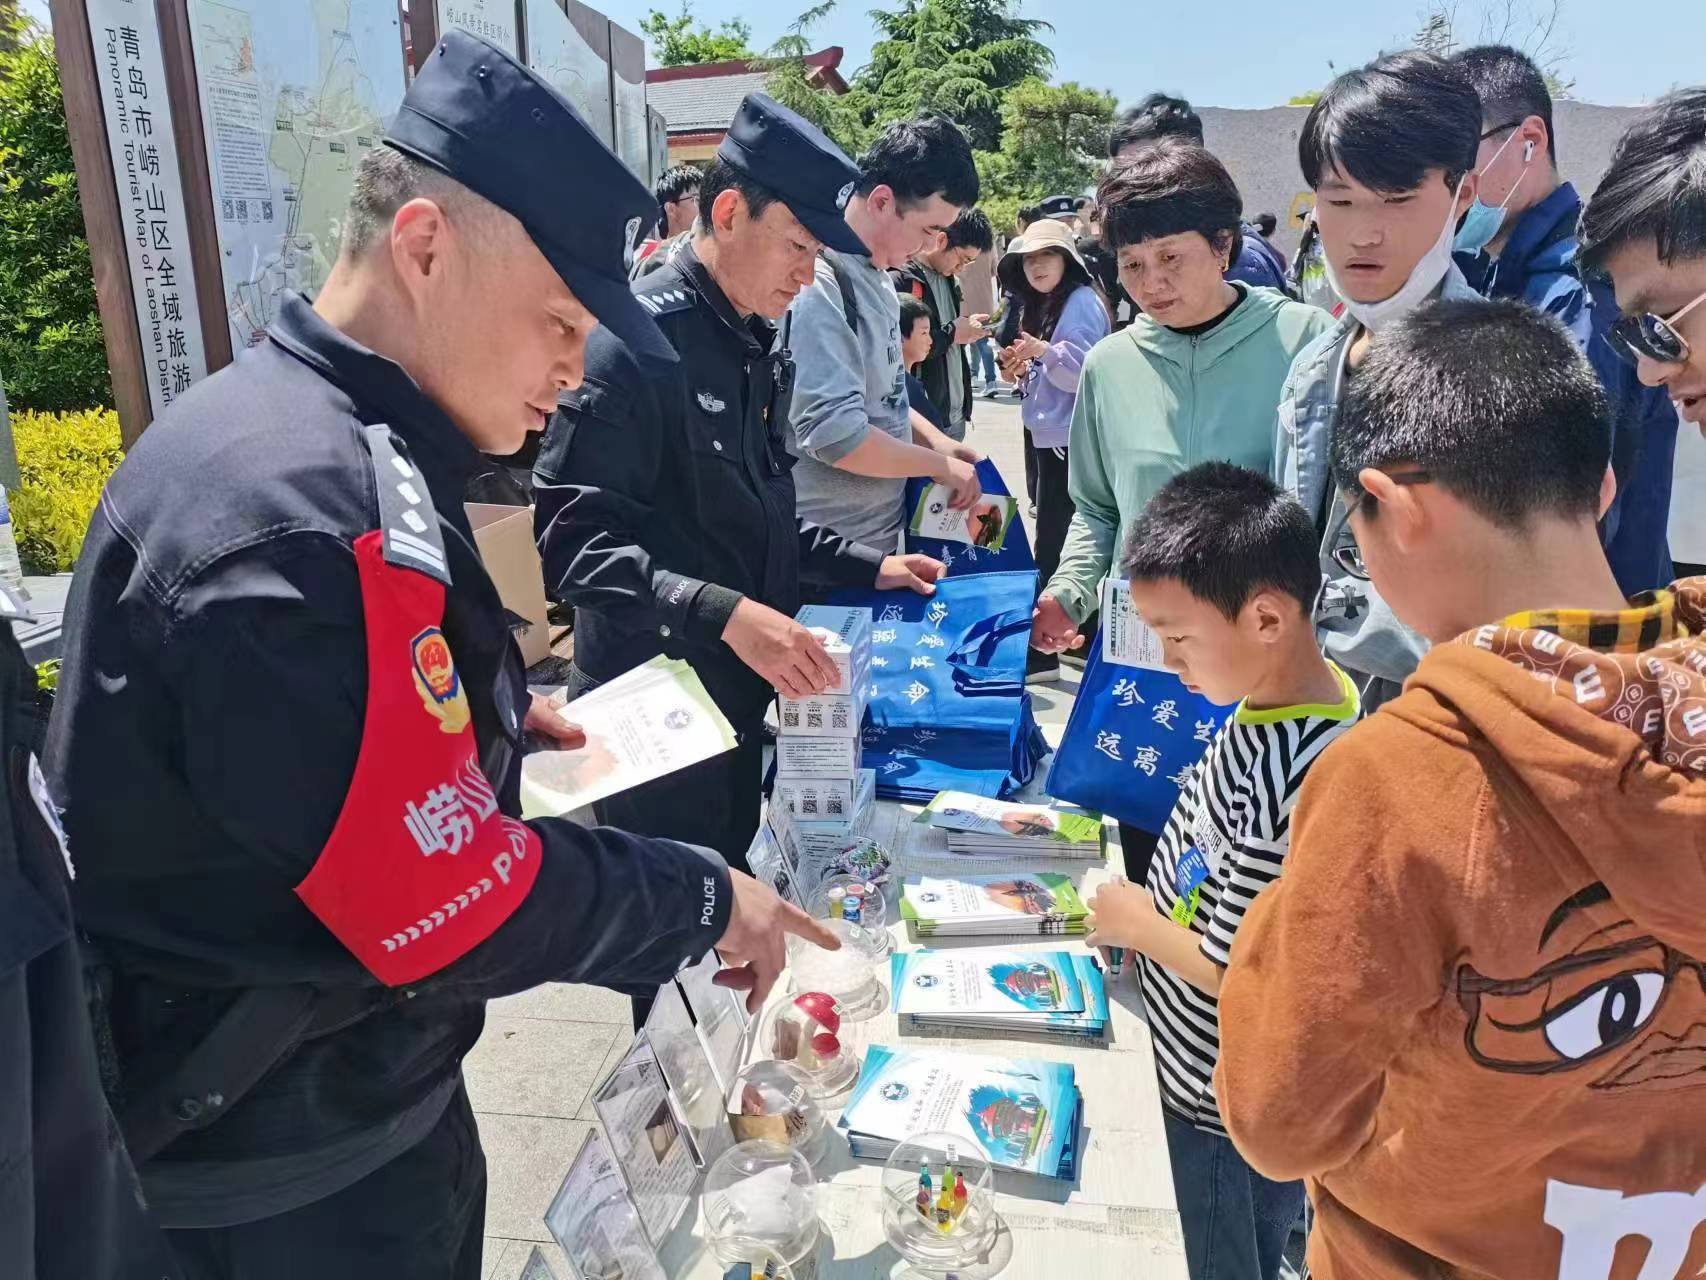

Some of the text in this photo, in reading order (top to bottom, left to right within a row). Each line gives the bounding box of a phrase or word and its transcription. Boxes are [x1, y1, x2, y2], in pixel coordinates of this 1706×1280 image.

[104, 28, 172, 407] Panoramic Tourist Map of Laoshan Distri
[119, 26, 192, 393] 青岛市崂山区全域旅游
[670, 580, 690, 604] POLICE
[901, 601, 949, 705] 珍爱生命
[1112, 679, 1216, 744] 珍爱生
[1094, 730, 1197, 790] 远离毒
[700, 876, 716, 926] POLICE
